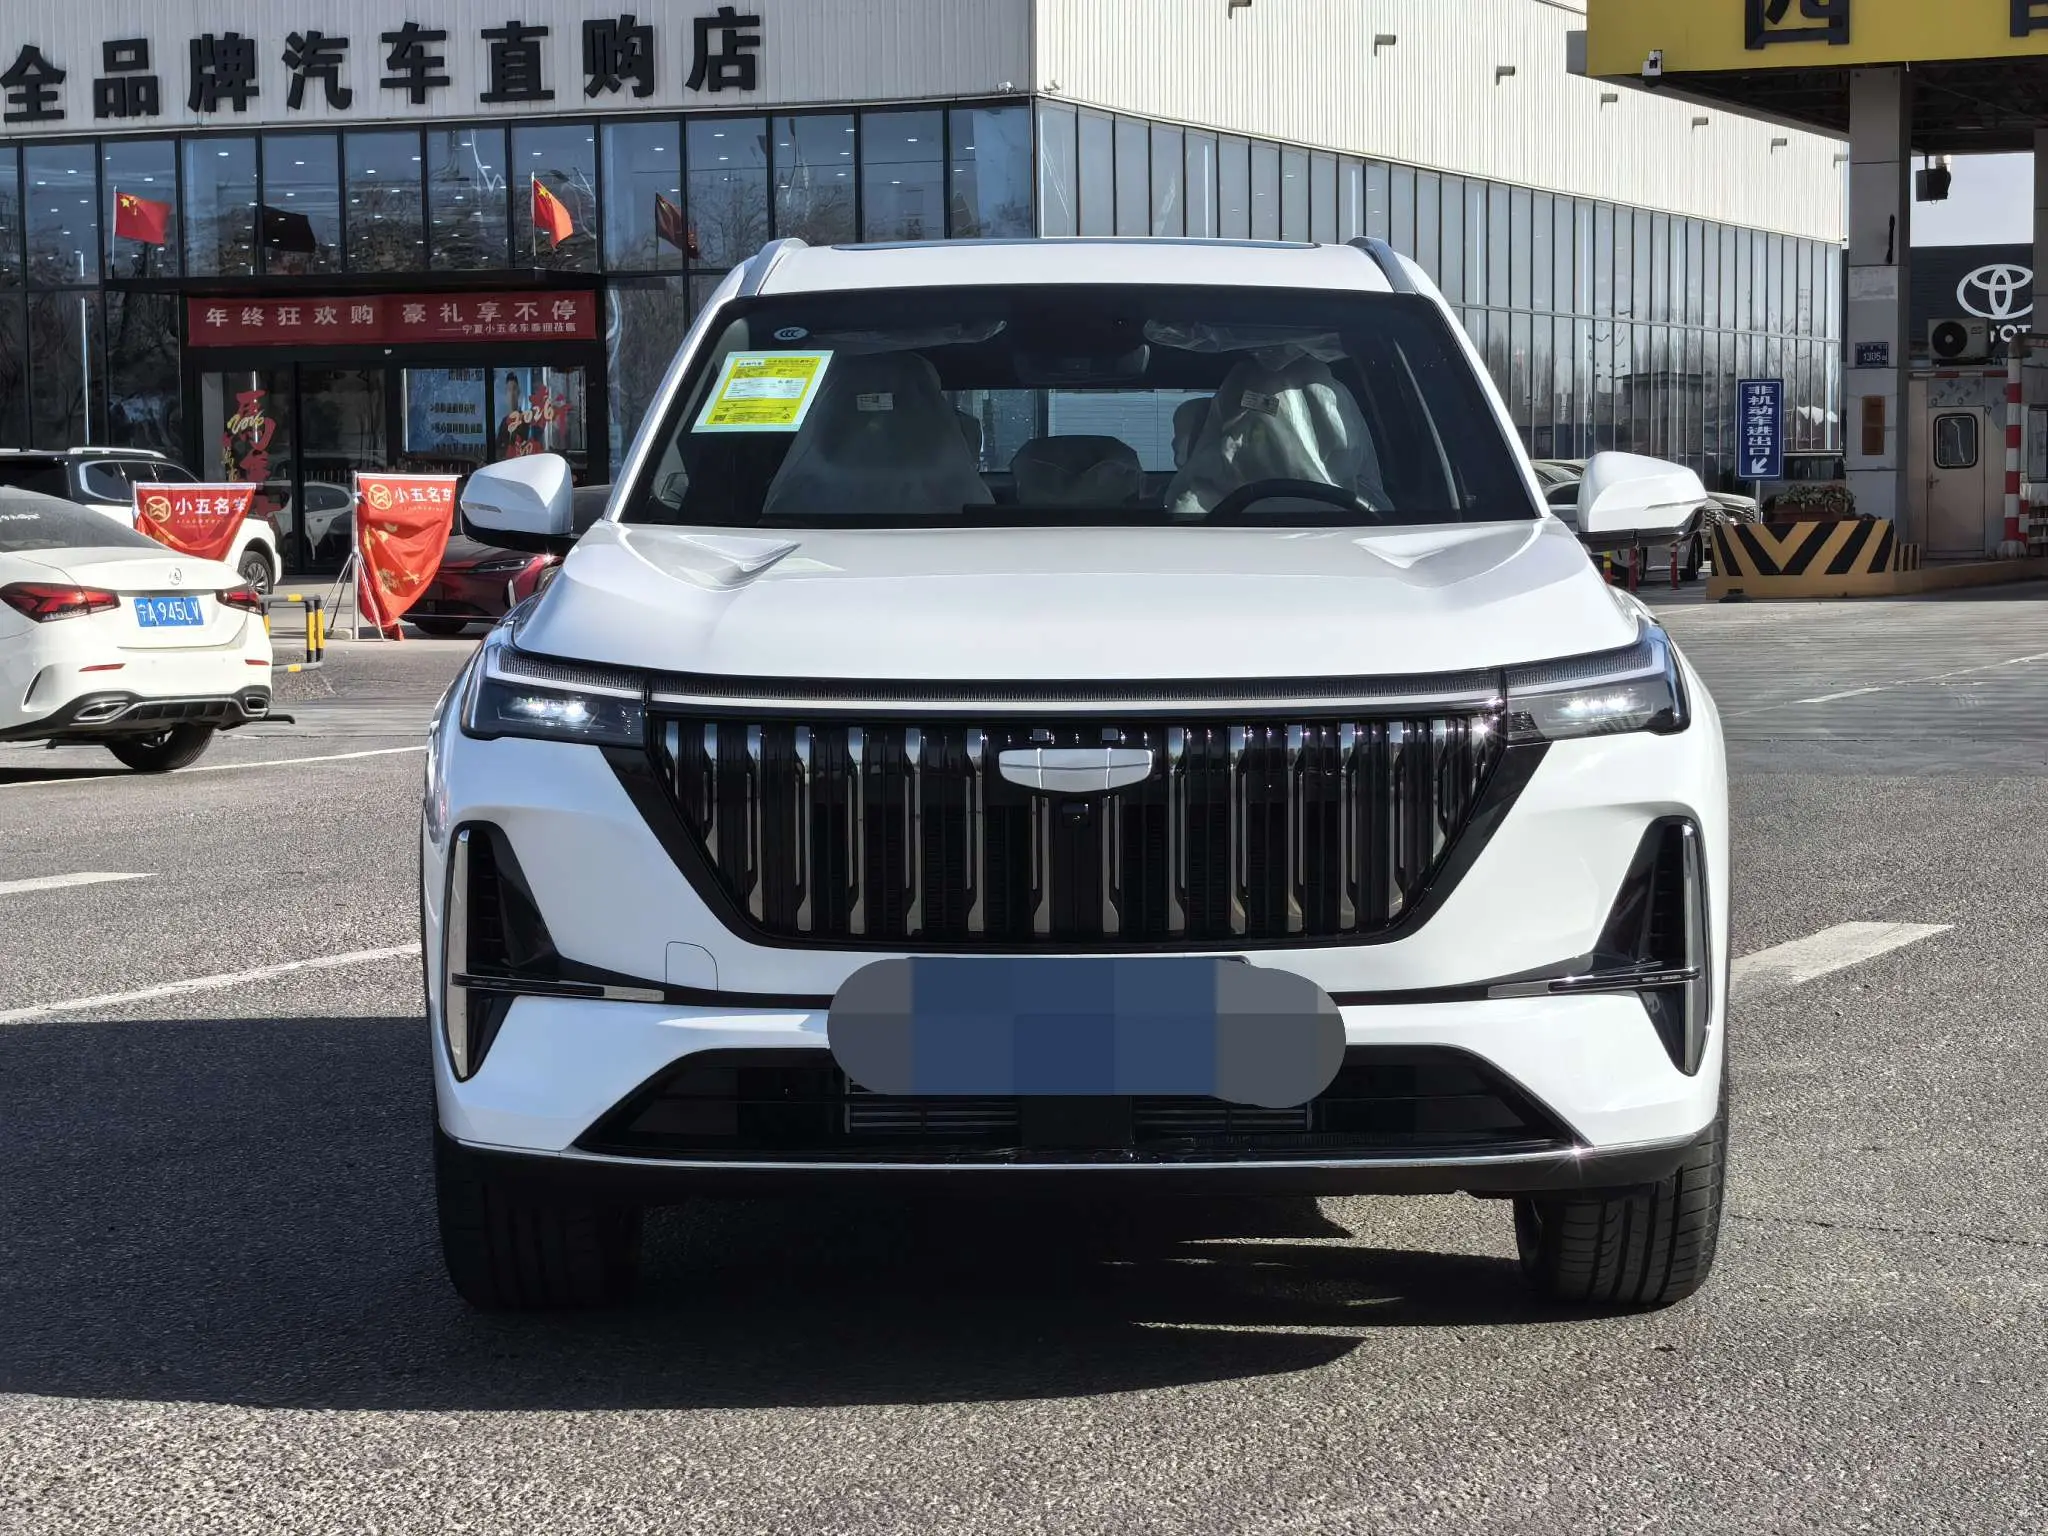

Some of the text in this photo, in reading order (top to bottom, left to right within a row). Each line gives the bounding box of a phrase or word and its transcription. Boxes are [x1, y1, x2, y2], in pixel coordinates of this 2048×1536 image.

[0, 6, 761, 123] 全品牌汽车直购店
[206, 299, 577, 327] 年终狂欢购 豪礼享不停
[1746, 385, 1775, 456] 非机动车进出口
